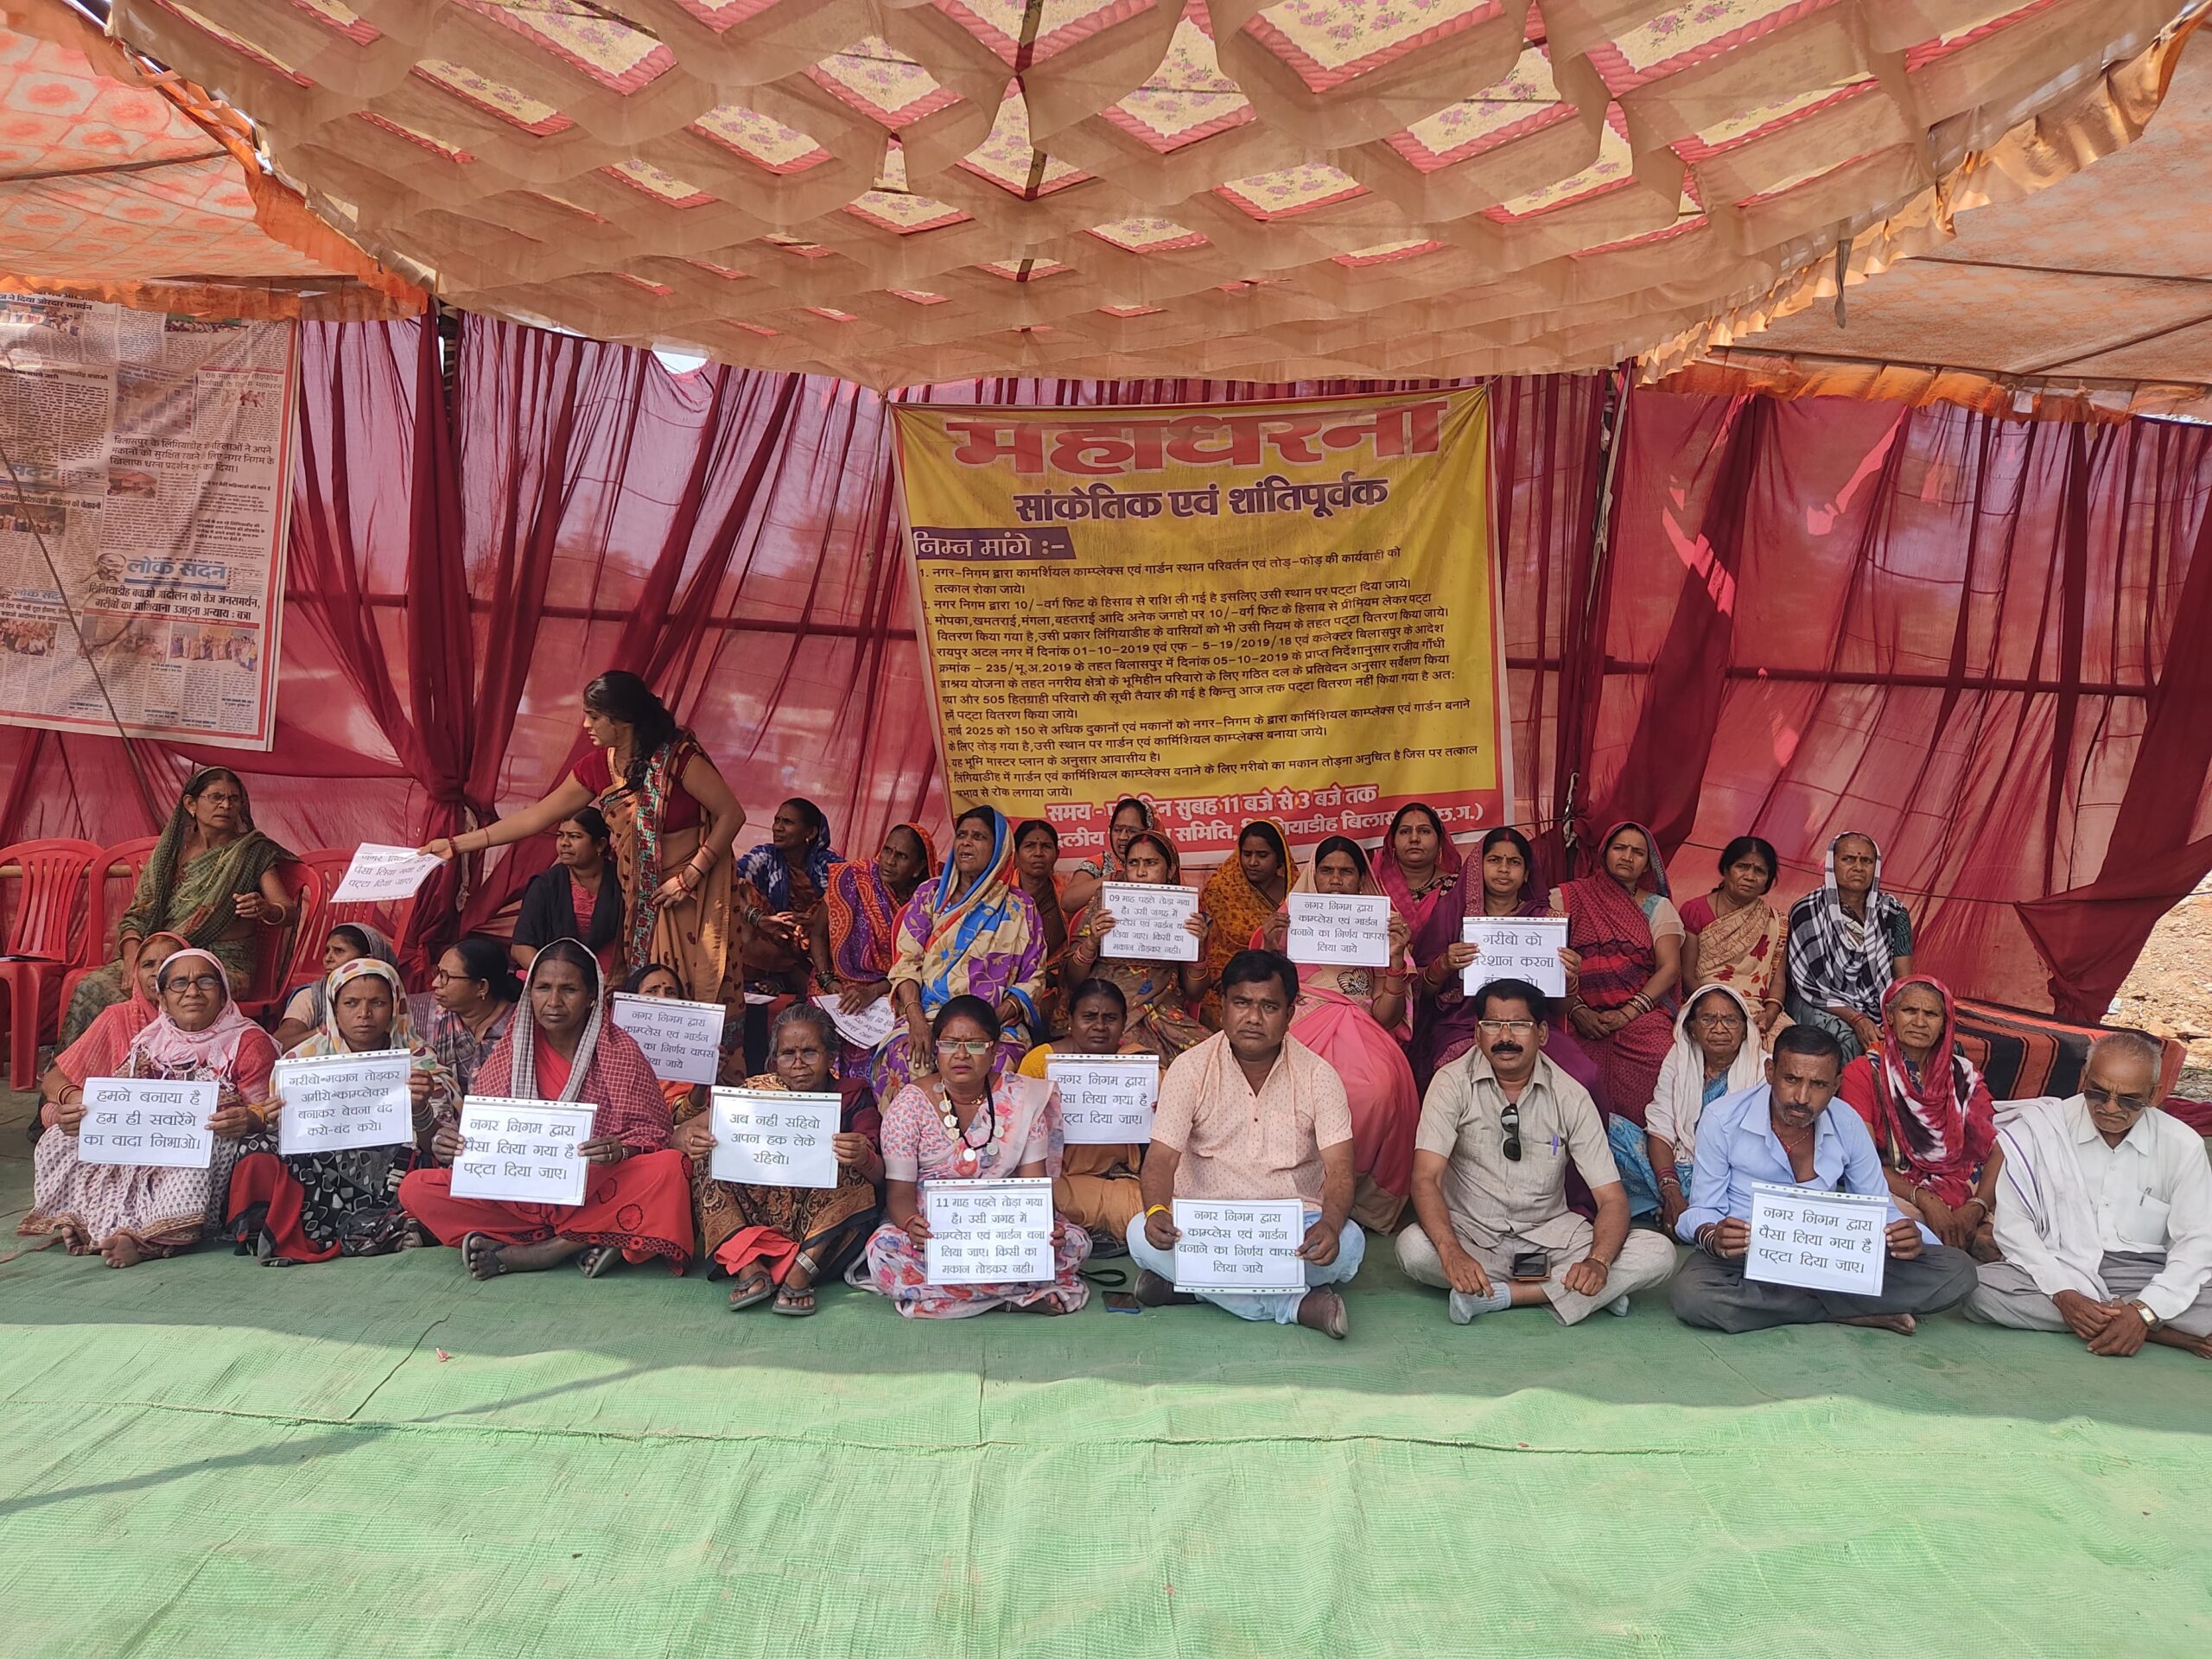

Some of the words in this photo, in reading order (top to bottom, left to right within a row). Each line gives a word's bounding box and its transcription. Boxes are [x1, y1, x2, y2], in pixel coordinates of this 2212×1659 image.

[946, 400, 1447, 474] महाधरना
[1014, 483, 1162, 521] सांकेतिक
[1168, 484, 1219, 517] एवं
[1230, 472, 1388, 517] शांतिपूर्वक
[913, 530, 972, 556] निम्न
[979, 531, 1032, 555] मांगे
[127, 556, 175, 574] लोक
[181, 562, 226, 579] सदन
[994, 569, 1012, 579] द्वारा
[1017, 566, 1070, 576] कामर्शियल
[1073, 564, 1123, 577] काम्प्लेक्स
[1128, 563, 1141, 576] एवं
[1145, 563, 1173, 574] गार्डन
[1177, 563, 1204, 573] स्थान
[1208, 558, 1248, 571] परिवर्तन
[1253, 557, 1266, 569] एवं
[1325, 552, 1338, 564] की
[1342, 550, 1383, 563] कार्यवाही
[1388, 546, 1400, 557] को
[191, 591, 201, 602] को
[204, 593, 215, 603] तेज
[121, 601, 130, 610] का
[133, 601, 169, 613] आशियाना
[203, 607, 229, 619] अन्याय
[939, 662, 970, 673] क्रमांक
[1074, 660, 1084, 671] के
[1088, 660, 1111, 672] तहत
[1116, 658, 1162, 671] बिलासपुर
[1178, 656, 1209, 667] दिनांक
[1292, 651, 1301, 661] के
[1306, 649, 1328, 659] प्राप्त
[1332, 644, 1389, 657] निर्देशानुसार
[1393, 640, 1419, 652] राजीव
[948, 724, 962, 735] मार्च
[997, 725, 1012, 735] को
[1039, 724, 1048, 734] से
[1052, 722, 1083, 734] अधिक
[1087, 722, 1118, 736] दुकानों
[1122, 721, 1136, 732] एवं
[1141, 719, 1173, 732] मकानों
[1177, 719, 1190, 730] को
[1255, 715, 1264, 725] के
[1268, 714, 1287, 724] द्वारा
[1351, 705, 1395, 718] काम्प्लेक्स
[1398, 702, 1411, 715] एवं
[1414, 700, 1441, 712] गार्डन
[1446, 698, 1470, 709] बनाने
[1046, 804, 1091, 821] समय
[1175, 798, 1217, 820] सुबह
[1222, 797, 1239, 813] 11
[1243, 790, 1273, 811] बजे
[1277, 788, 1294, 810] से
[1299, 793, 1310, 809] 3
[1314, 785, 1342, 806] बजे
[1345, 785, 1377, 804] तक
[365, 1070, 400, 1081] तोड़कर
[97, 1088, 131, 1102] हमने
[140, 1090, 182, 1103] बनाया
[190, 1090, 200, 1105] है
[96, 1112, 118, 1124] हम
[126, 1109, 142, 1125] ही
[149, 1111, 197, 1126] सवारेंगे
[298, 1109, 336, 1119] बनाकर
[341, 1105, 371, 1116] बेचना
[378, 1103, 392, 1114] बंद
[470, 1118, 499, 1131] नगर
[507, 1117, 543, 1134] निगम
[550, 1124, 576, 1137] द्वारा
[730, 1114, 749, 1124] अब
[755, 1114, 778, 1127] नही
[785, 1116, 820, 1128] सहिबो
[85, 1134, 105, 1146] का
[112, 1135, 143, 1147] वादा
[464, 1136, 491, 1153] पैसा
[497, 1139, 527, 1154] लिया
[533, 1145, 558, 1157] गया
[564, 1144, 575, 1160] है
[731, 1133, 760, 1144] अपन
[767, 1135, 787, 1146] हक
[794, 1134, 816, 1147] लेके
[464, 1162, 497, 1178] पट्टा
[505, 1161, 532, 1177] दिया
[936, 1198, 949, 1207] 11
[952, 1198, 969, 1208] माह
[975, 1196, 996, 1207] पहले
[1001, 1196, 1020, 1208] तोड़ा
[1026, 1198, 1043, 1207] गया
[969, 1212, 986, 1224] उसी
[992, 1214, 1015, 1224] जगह
[1194, 1211, 1219, 1221] नगर
[1225, 1210, 1254, 1222] निगम
[1260, 1213, 1281, 1224] द्वारा
[1764, 1206, 1795, 1221] नगर
[1802, 1209, 1840, 1226] निगम
[1847, 1218, 1872, 1231] द्वारा
[977, 1230, 990, 1240] एवं
[995, 1229, 1021, 1239] गार्डन
[1027, 1230, 1045, 1239] बना
[1188, 1226, 1231, 1239] काम्प्लेस
[1238, 1228, 1252, 1239] एवं
[1259, 1228, 1287, 1240] गार्डन
[1758, 1224, 1786, 1241] पैसा
[1793, 1229, 1822, 1246] लिया
[1830, 1236, 1855, 1250] गया
[1862, 1238, 1872, 1254] है
[941, 1246, 962, 1257] लिया
[995, 1245, 1019, 1257] किसी
[1025, 1247, 1037, 1256] का
[1179, 1242, 1208, 1254] बनाने
[1214, 1245, 1228, 1255] का
[1235, 1244, 1263, 1256] निर्णय
[1269, 1248, 1297, 1256] वापस
[1759, 1247, 1792, 1264] पट्टा
[1801, 1250, 1828, 1268] दिया
[943, 1265, 969, 1274] मकान
[976, 1262, 1007, 1274] तोड़कर
[1214, 1261, 1236, 1272] लिया
[1243, 1262, 1263, 1274] जाये
